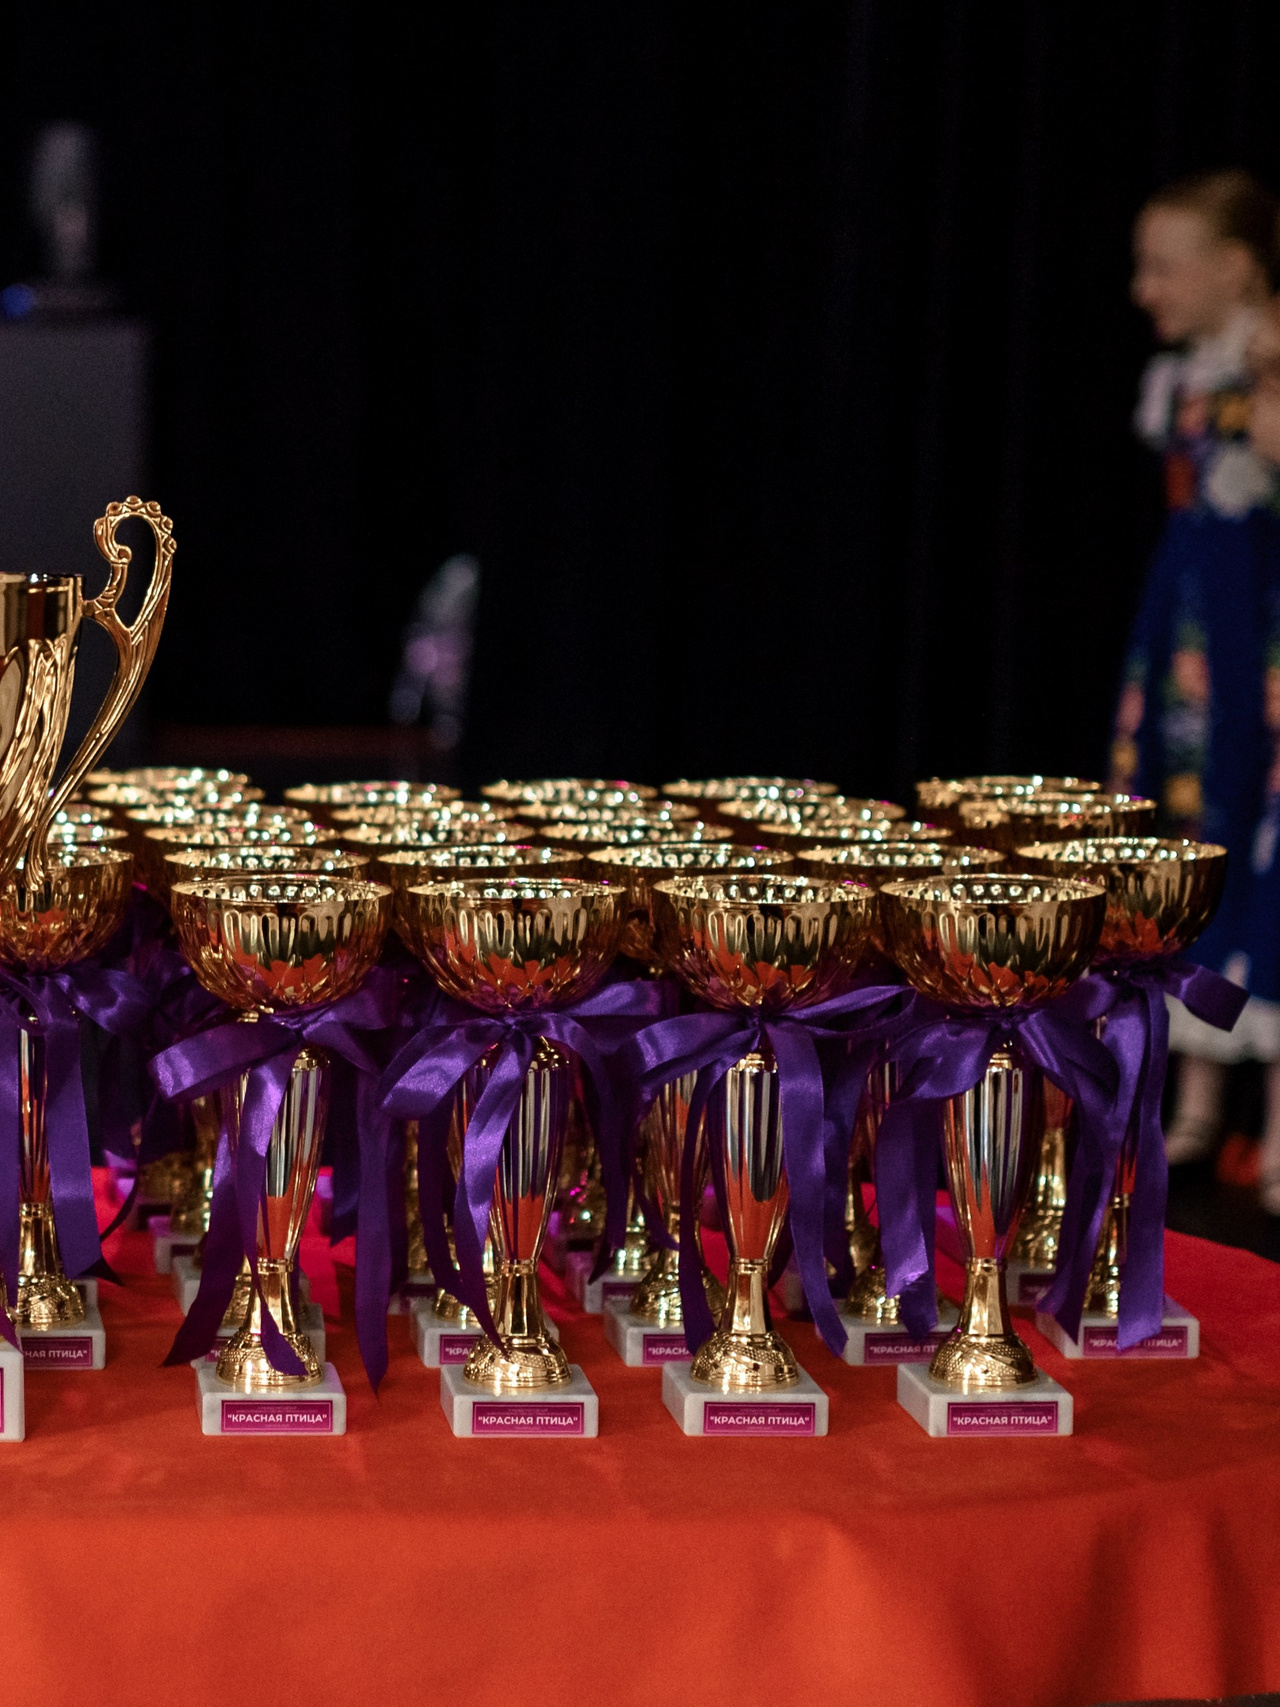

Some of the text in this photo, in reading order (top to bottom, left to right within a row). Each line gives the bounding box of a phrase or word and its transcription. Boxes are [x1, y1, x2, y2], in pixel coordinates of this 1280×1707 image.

[48, 1349, 88, 1359] ПТИЦА"
[227, 1413, 327, 1424] "КРАСНАЯ ПТИЦА"
[478, 1415, 578, 1426] "КРАСНАЯ ПТИЦА"
[710, 1416, 810, 1426] "КРАСНАЯ ПТИЦА"
[953, 1415, 1053, 1426] "КРАСНАЯ ПТИЦА"
